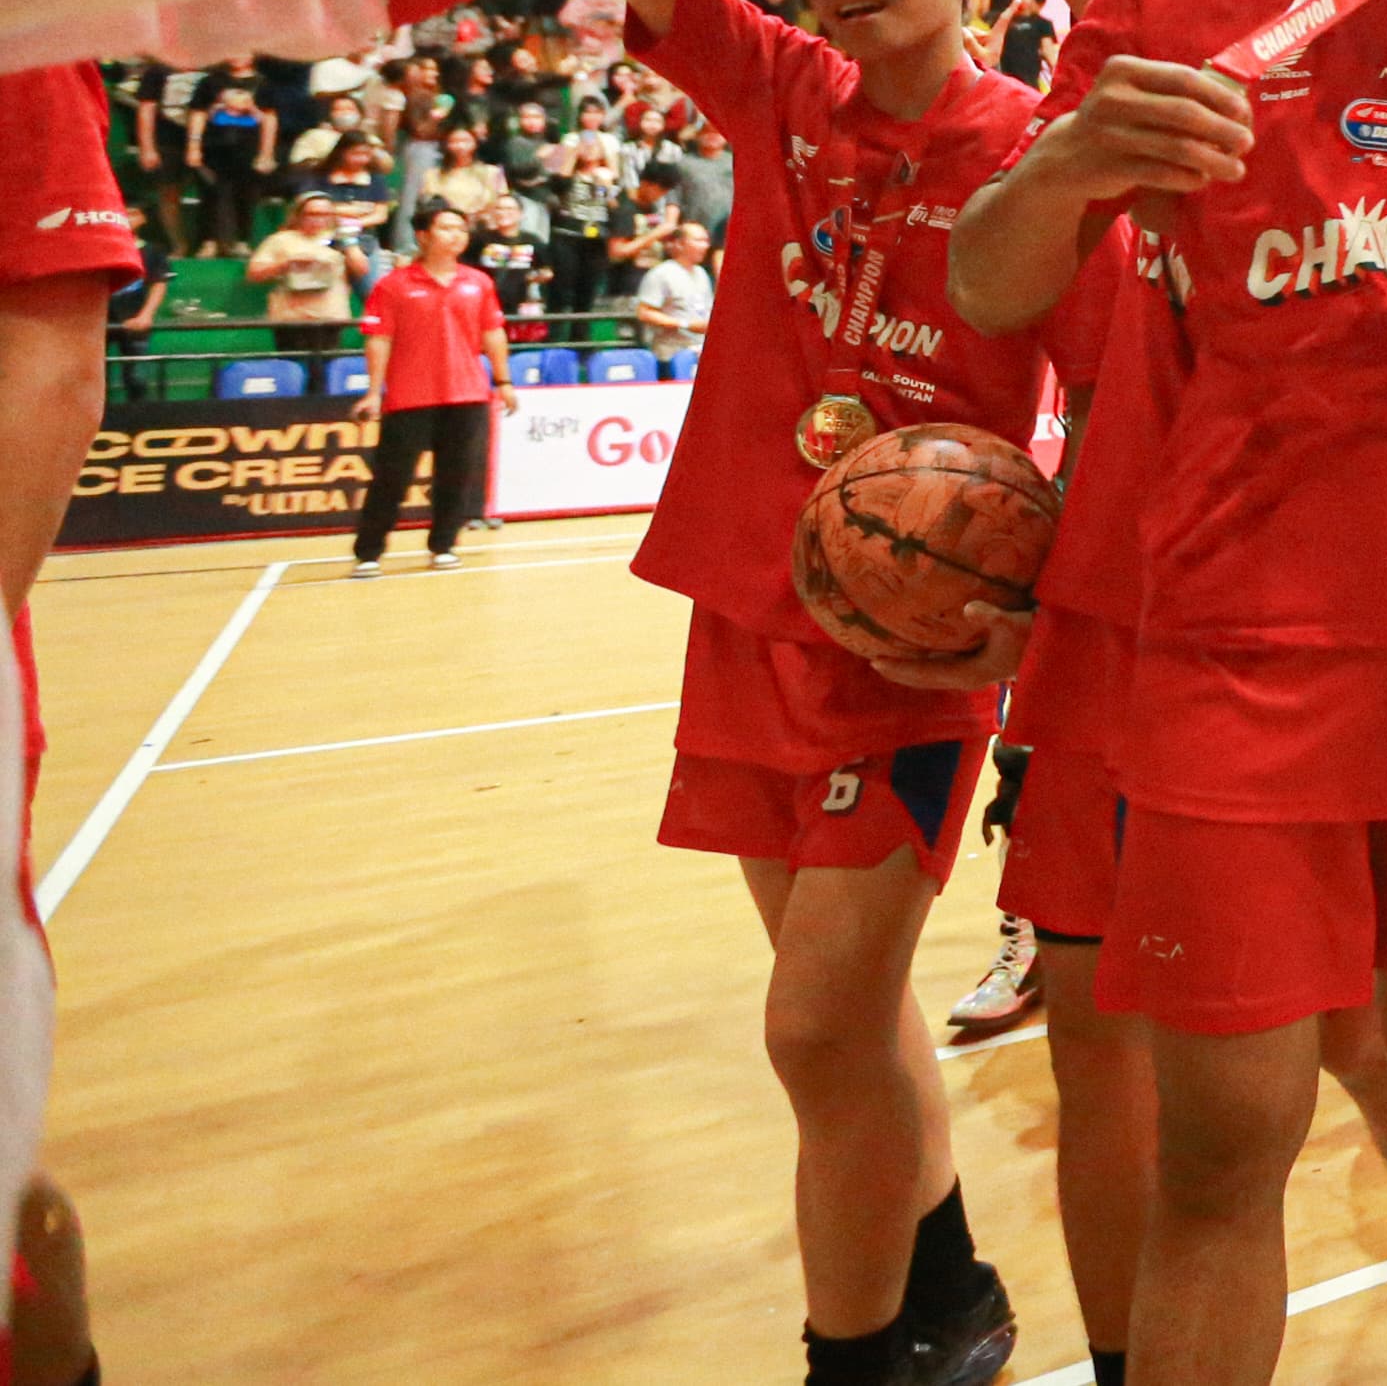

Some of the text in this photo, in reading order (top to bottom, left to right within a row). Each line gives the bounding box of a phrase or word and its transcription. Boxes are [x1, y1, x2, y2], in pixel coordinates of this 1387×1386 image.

[843, 249, 887, 347] CHAMPION
[892, 373, 937, 394] SOUTH
[587, 416, 674, 467] Go
[72, 454, 374, 497] CE CREA
[249, 488, 349, 516] ULTRA
